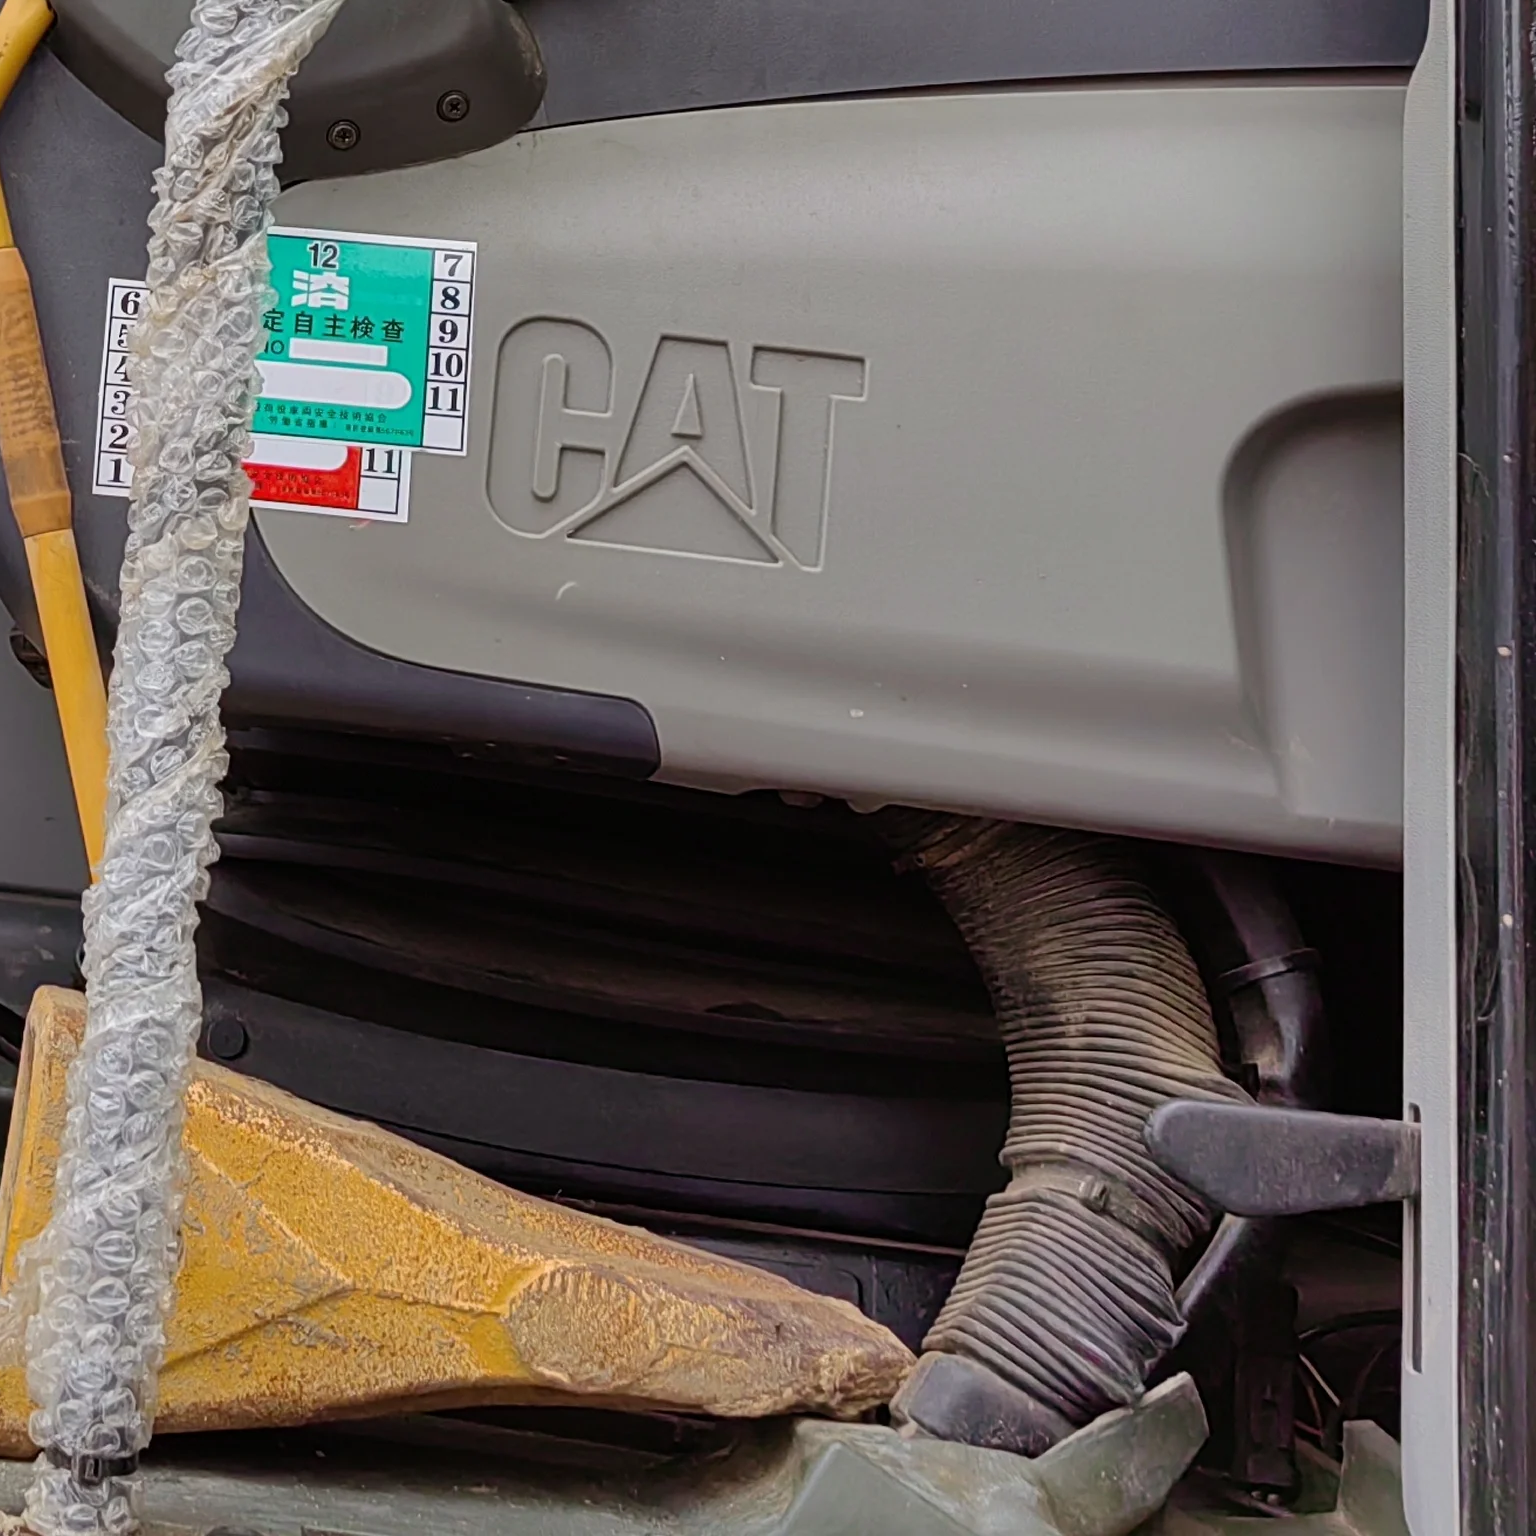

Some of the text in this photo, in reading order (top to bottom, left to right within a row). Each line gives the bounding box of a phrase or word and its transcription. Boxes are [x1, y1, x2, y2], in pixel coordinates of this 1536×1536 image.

[308, 242, 338, 269] 12
[443, 254, 463, 277] 7
[120, 291, 141, 315] 6
[440, 286, 460, 310] 8
[438, 319, 459, 344] 9
[429, 352, 463, 378] 10
[110, 390, 131, 415] 3
[427, 385, 461, 412] 11
[108, 424, 130, 449] 2
[485, 315, 871, 573] CAT
[107, 458, 126, 483] 1
[364, 448, 396, 474] 11
